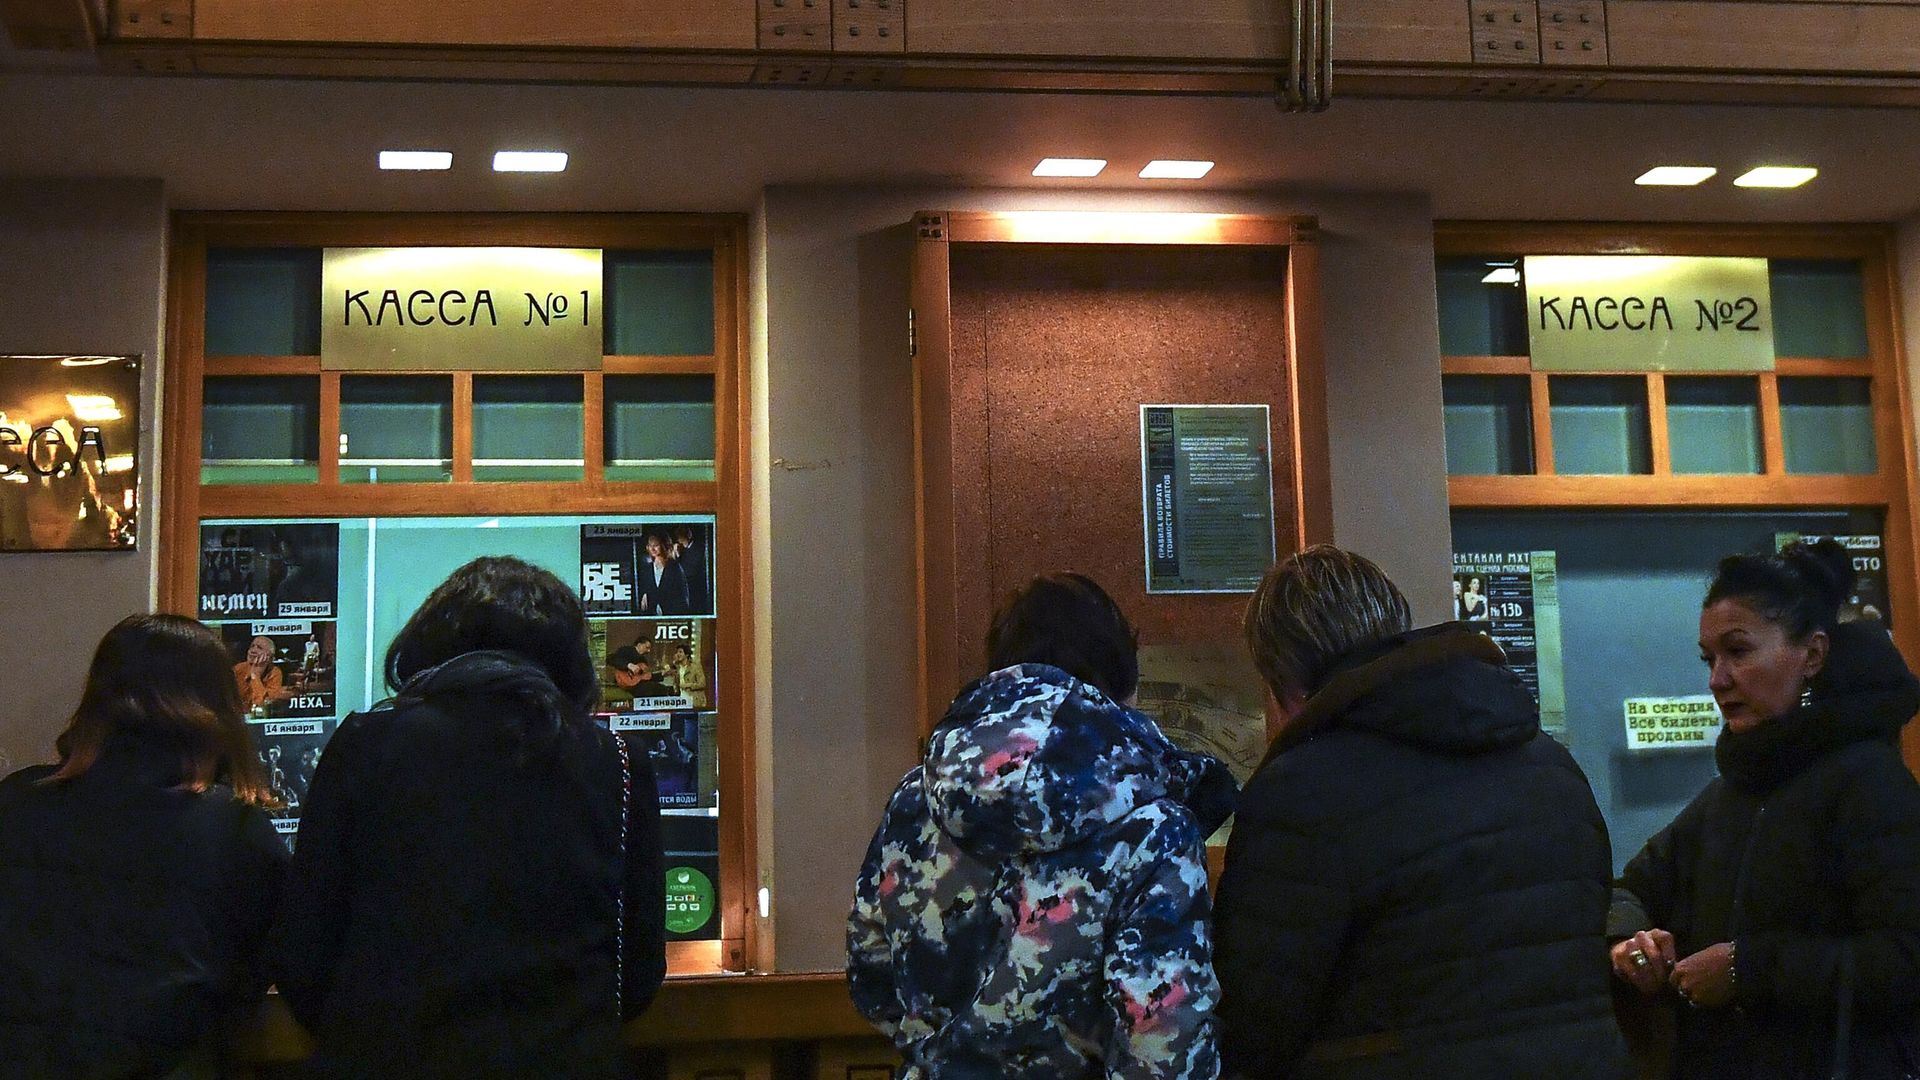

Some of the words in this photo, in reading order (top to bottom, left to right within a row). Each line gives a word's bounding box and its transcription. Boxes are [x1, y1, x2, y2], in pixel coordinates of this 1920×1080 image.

[343, 290, 498, 327] КАССА
[1539, 296, 1673, 331] КАССА
[1694, 296, 1760, 332] №2
[1163, 474, 1172, 510] БИЛЕТОВ
[593, 526, 605, 534] 23
[606, 527, 640, 536] января
[1165, 511, 1174, 559] СТОИМОСТИ
[1508, 553, 1530, 563] МХТ
[1852, 556, 1880, 571] СТО
[583, 562, 620, 585] БЕ
[280, 605, 291, 613] 29
[293, 605, 330, 615] января
[253, 623, 266, 633] 17
[267, 623, 302, 634] января
[654, 625, 689, 640] ЛЕС
[640, 698, 651, 707] 21
[652, 698, 687, 708] января
[1627, 702, 1647, 714] На
[1652, 702, 1714, 714] сегодня
[618, 717, 631, 726] 22
[632, 718, 666, 728] января
[1629, 716, 1656, 729] Все
[1661, 716, 1719, 728] билеты
[266, 724, 278, 733] 14
[279, 724, 315, 735] января
[1637, 731, 1704, 743] проданы
